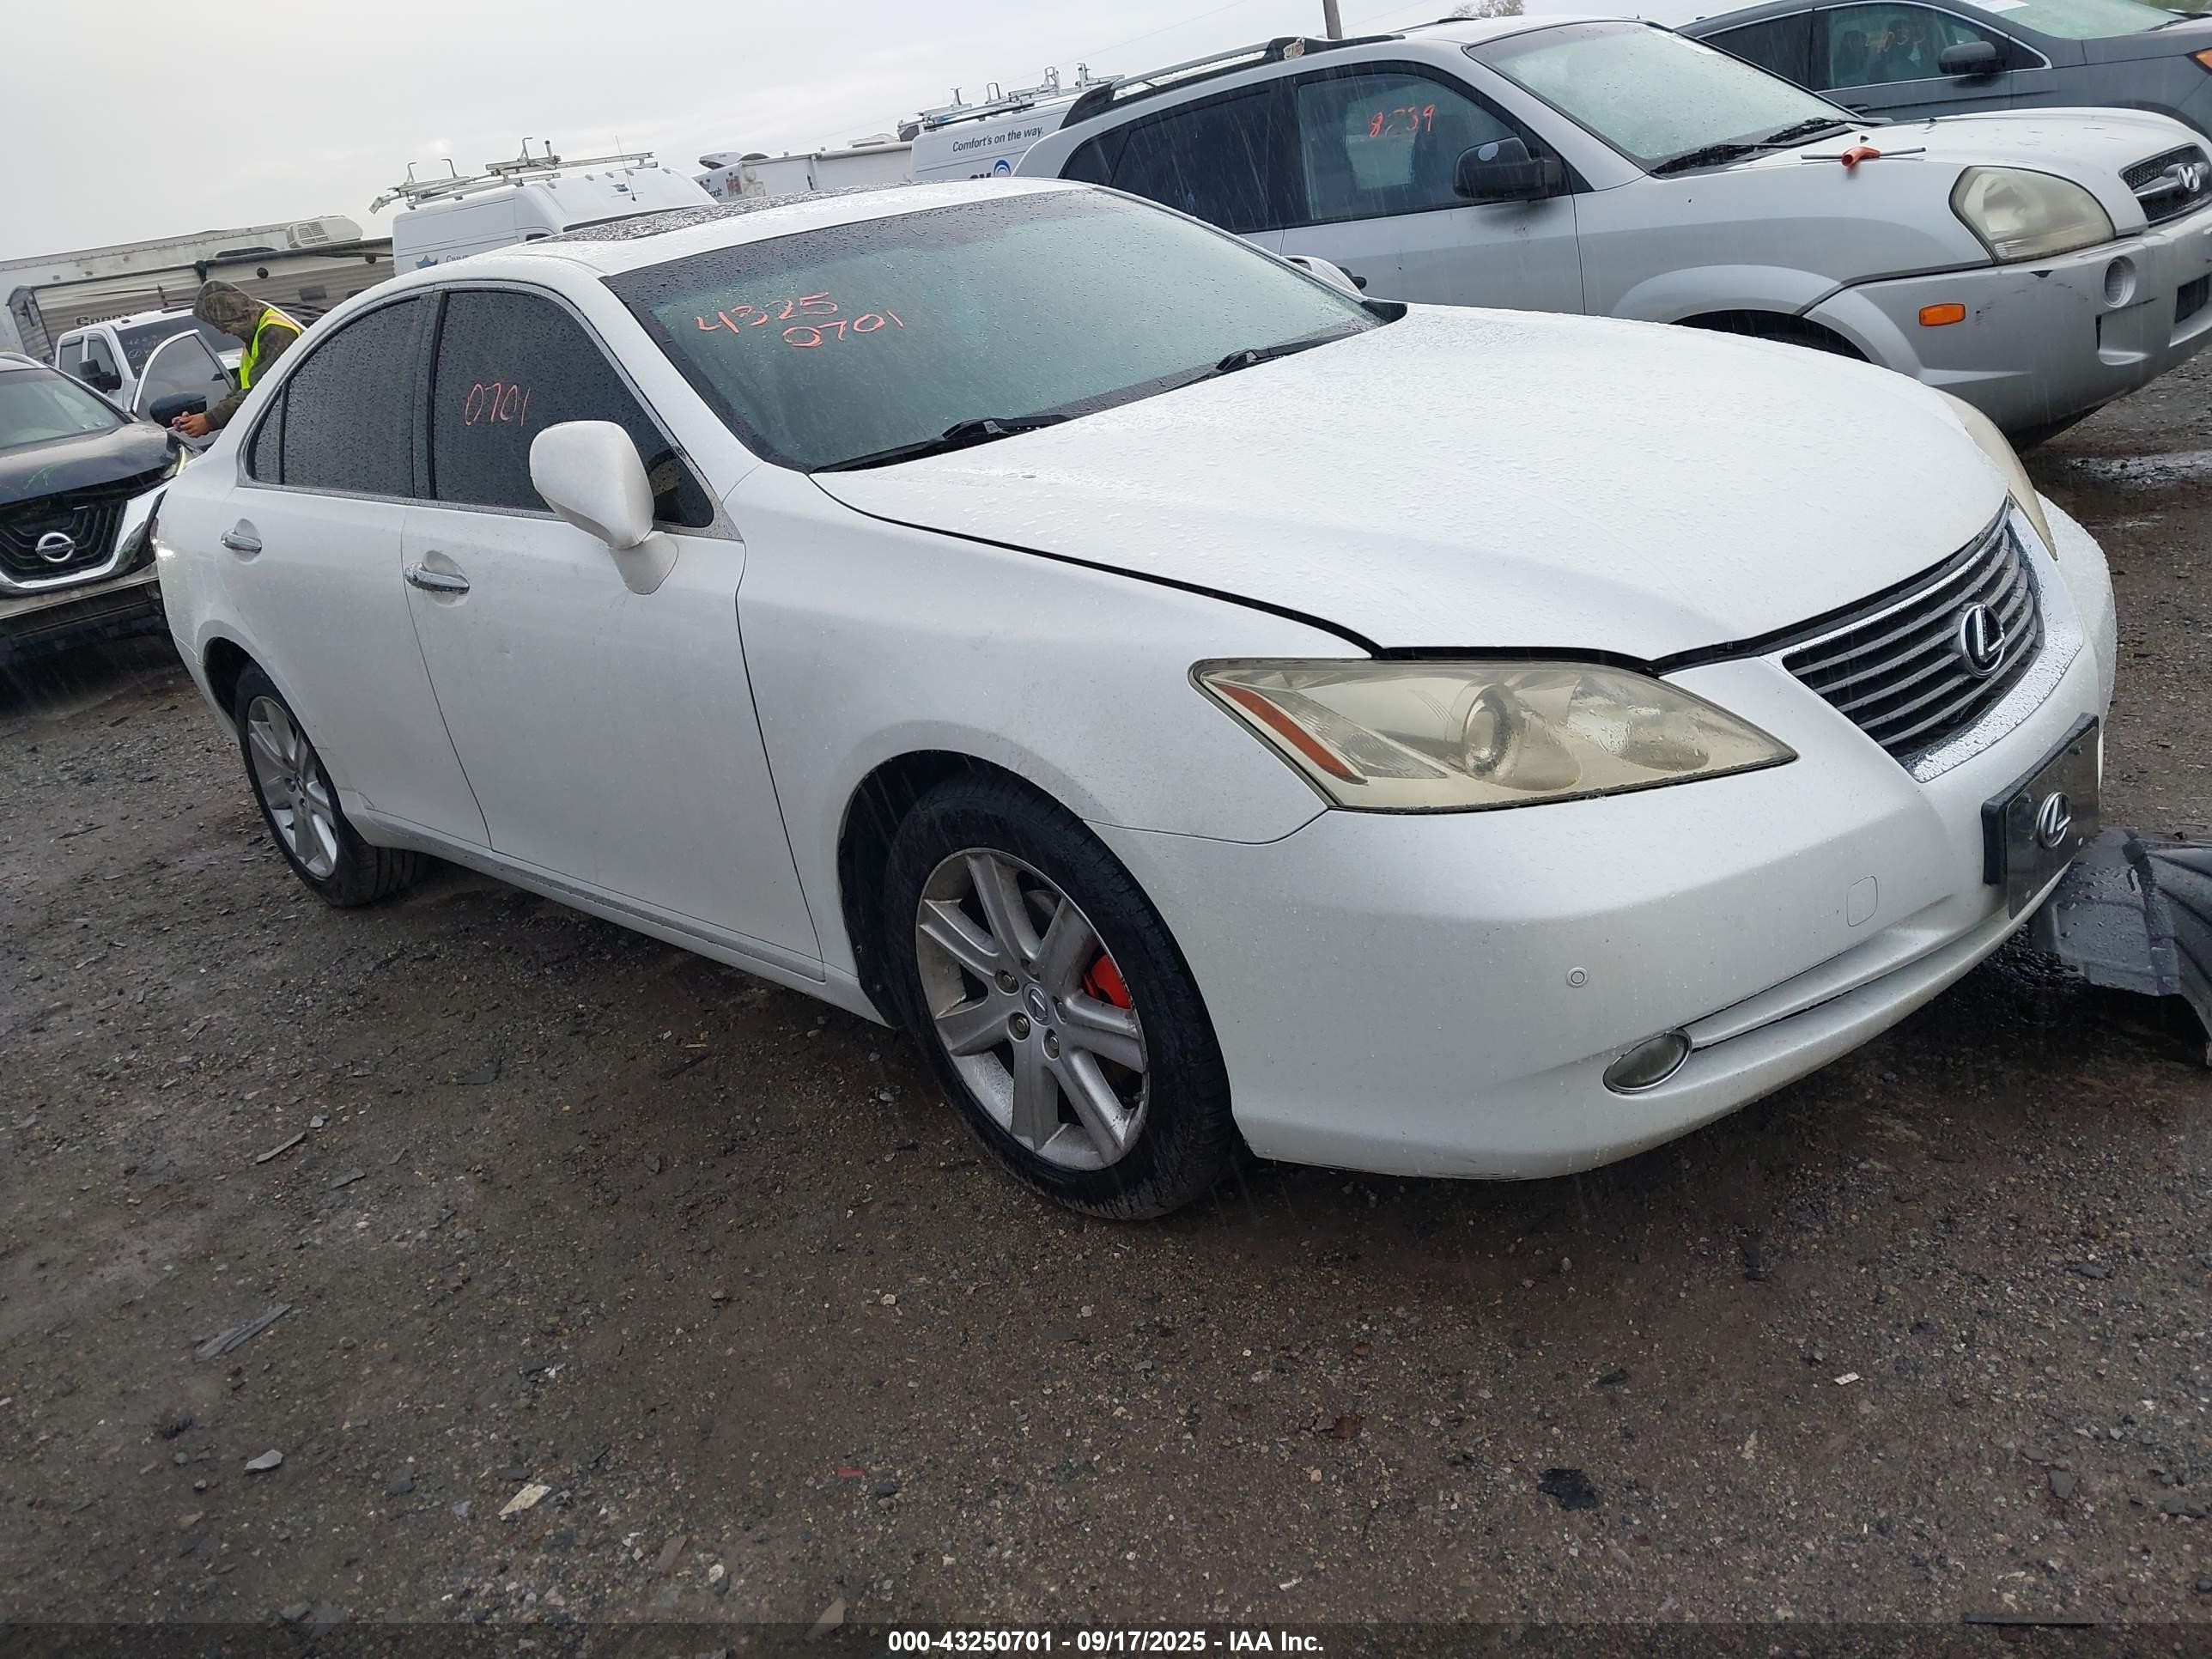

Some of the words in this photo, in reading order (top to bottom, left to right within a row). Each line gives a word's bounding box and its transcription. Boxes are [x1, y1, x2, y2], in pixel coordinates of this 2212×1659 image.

[952, 135, 992, 152] Comfort's
[994, 134, 1006, 144] on
[1007, 130, 1022, 142] the
[1024, 126, 1043, 137] way.
[696, 292, 838, 333] 4325
[783, 310, 903, 347] 0701
[465, 383, 531, 426] 0701
